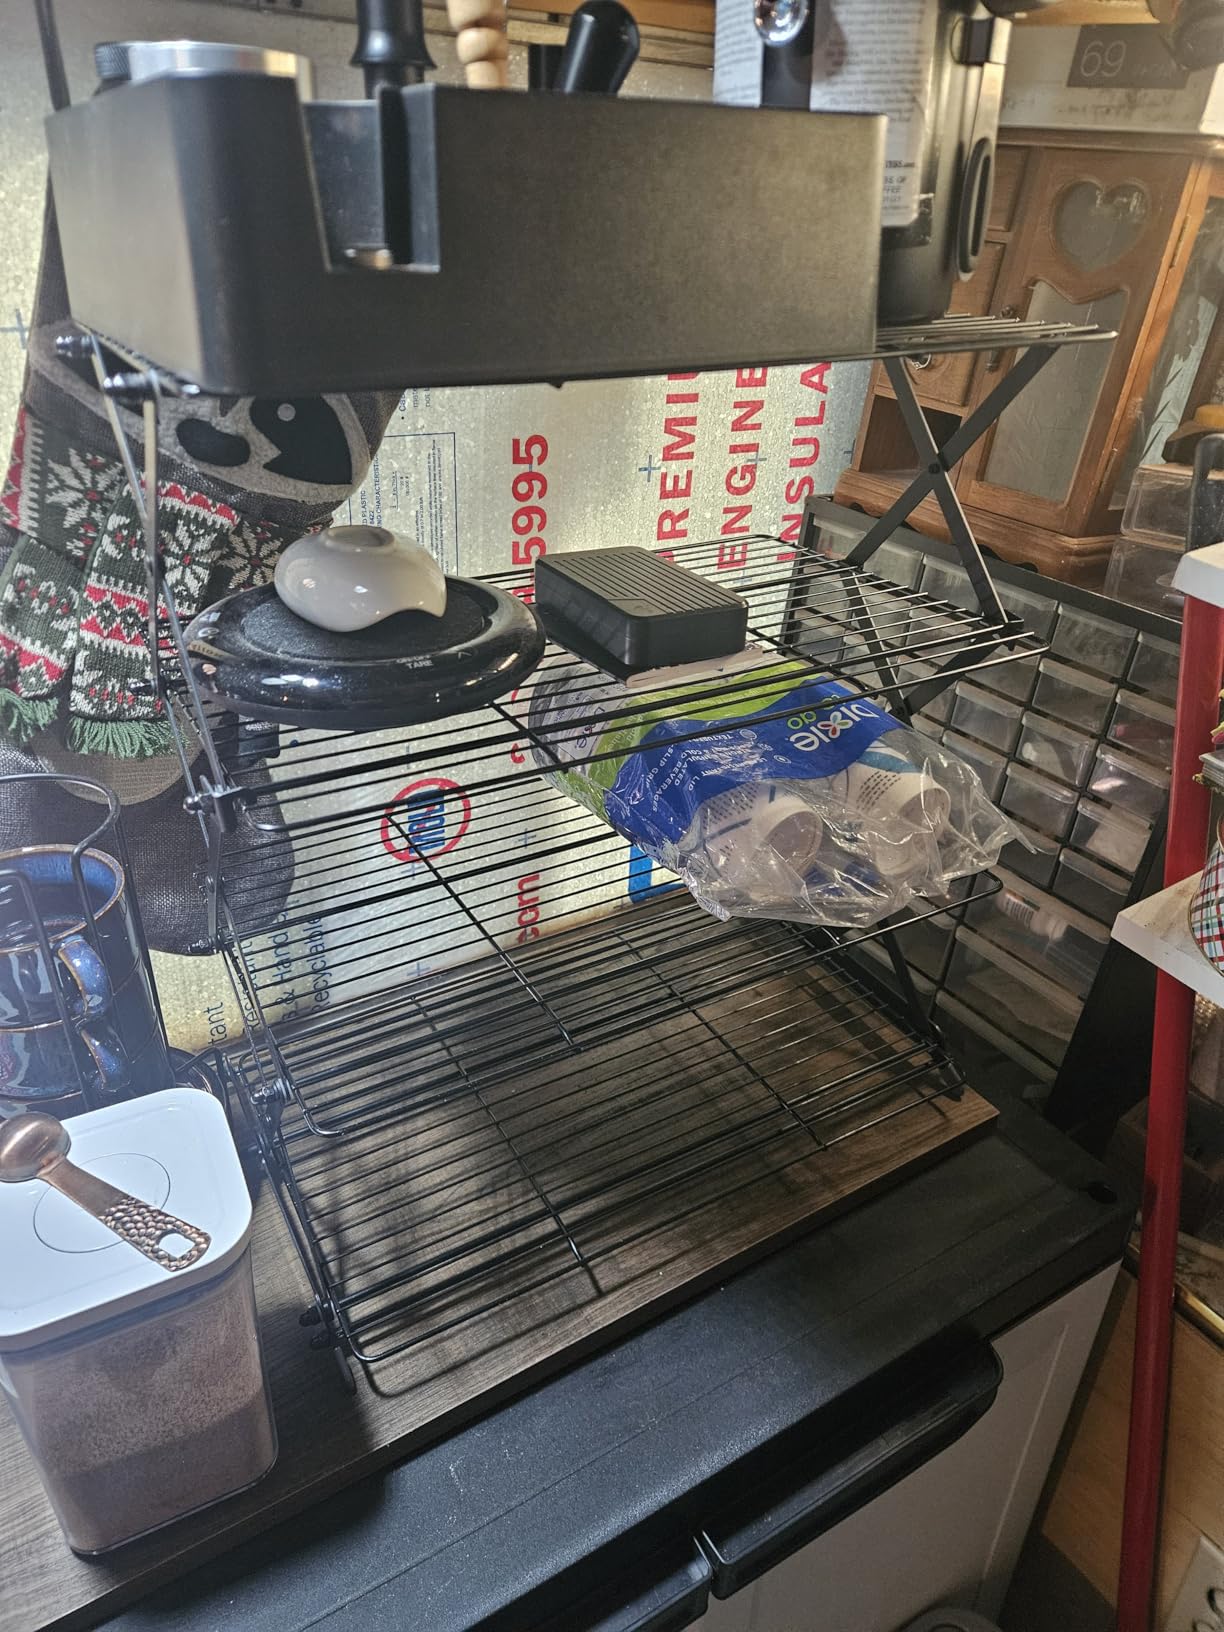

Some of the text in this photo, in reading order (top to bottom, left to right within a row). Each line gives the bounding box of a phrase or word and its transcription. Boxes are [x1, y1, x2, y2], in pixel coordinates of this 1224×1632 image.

[1080, 40, 1127, 77] 69
[657, 371, 700, 562] REMI
[405, 660, 434, 669] TARE
[652, 761, 683, 812] BEVERAGES
[688, 775, 700, 791] LID
[204, 1002, 227, 1045] tant
